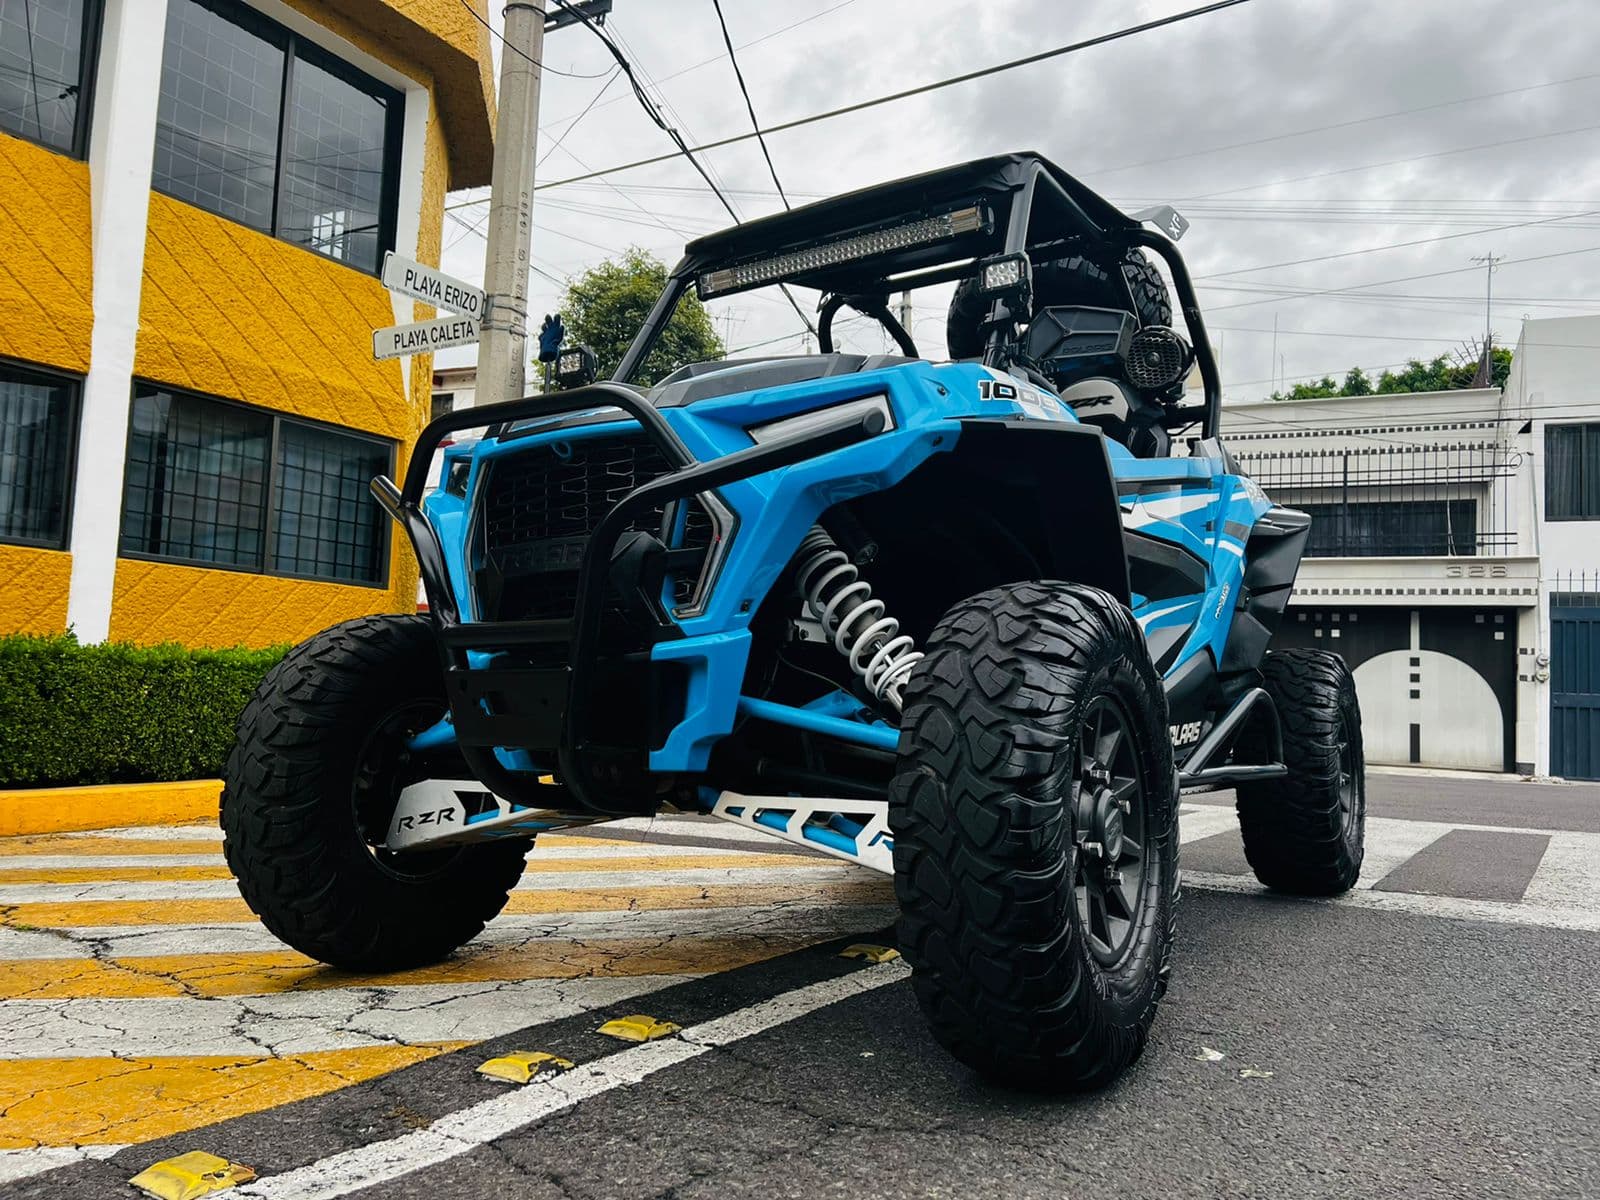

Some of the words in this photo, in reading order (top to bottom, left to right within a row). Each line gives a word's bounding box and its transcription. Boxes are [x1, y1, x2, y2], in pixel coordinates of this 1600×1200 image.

[404, 268, 442, 300] PLAYA
[444, 284, 478, 313] ERIZO
[394, 328, 428, 350] PLAYA
[430, 320, 475, 343] CALETA
[978, 379, 1060, 414] 1000
[1169, 720, 1202, 746] OLARIS
[397, 807, 456, 833] RZR
